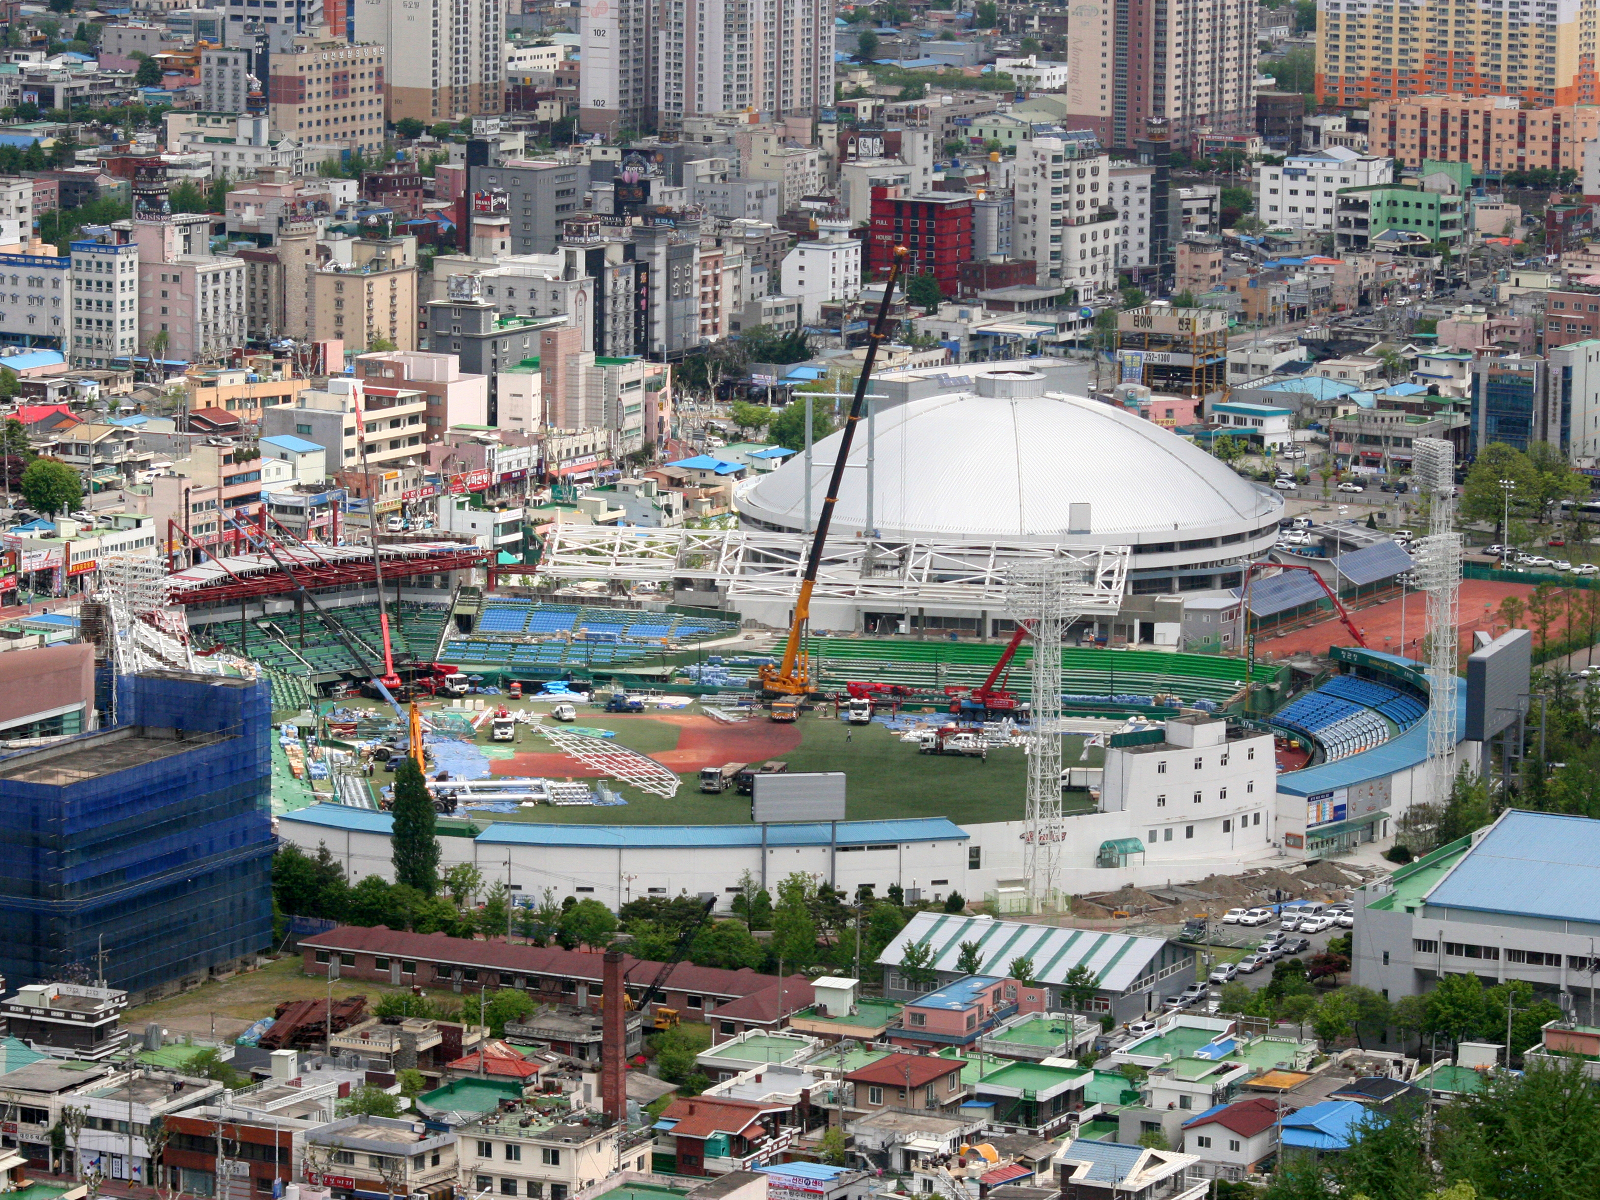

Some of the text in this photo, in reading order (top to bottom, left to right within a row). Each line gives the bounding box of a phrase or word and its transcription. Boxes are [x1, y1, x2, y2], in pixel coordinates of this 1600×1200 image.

[593, 29, 606, 37] 102
[1069, 37, 1083, 106] Morning Vill
[592, 99, 605, 107] 102
[135, 212, 162, 221] Oasis
[1133, 314, 1153, 329] 타이어
